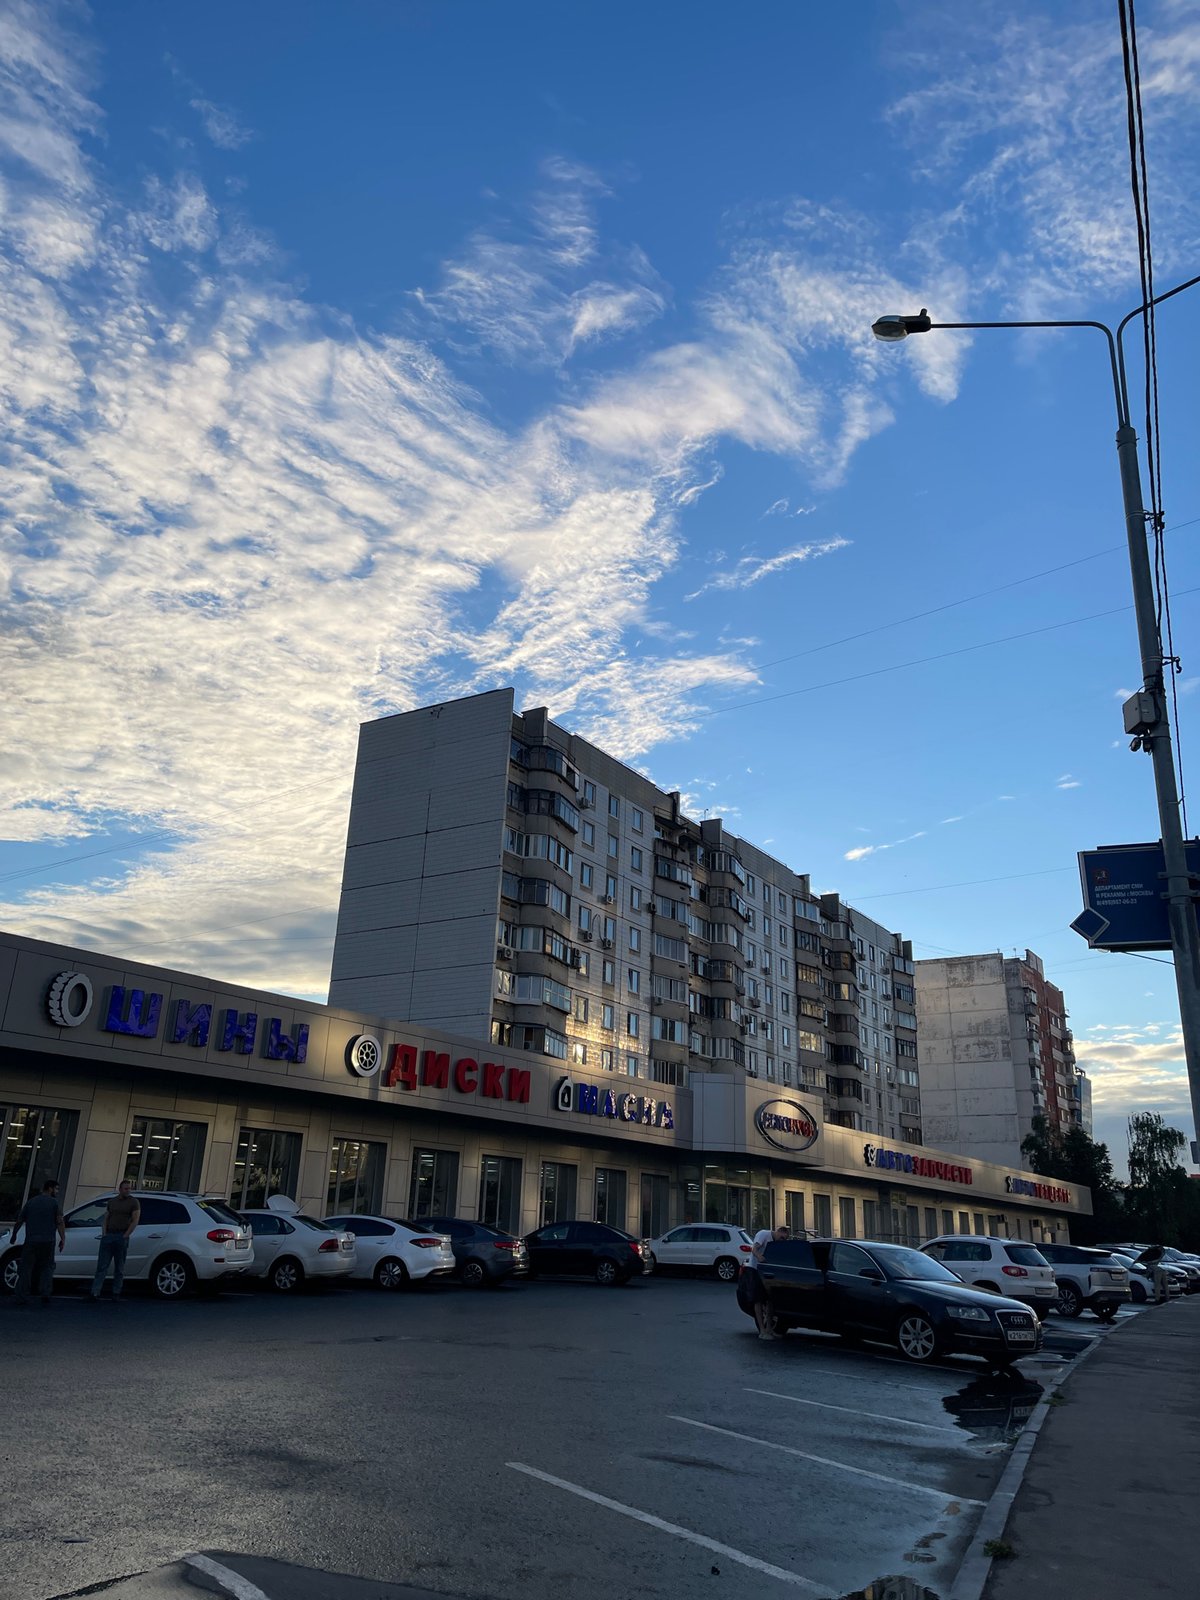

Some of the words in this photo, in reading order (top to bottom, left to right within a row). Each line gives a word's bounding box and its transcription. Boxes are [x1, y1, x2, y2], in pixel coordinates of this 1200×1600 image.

[103, 985, 310, 1063] ШИНЫ
[384, 1043, 531, 1103] ДИСКИ
[574, 1083, 674, 1129] МАСЛА
[876, 1148, 973, 1185] АВТОЗАПЧАСТИ
